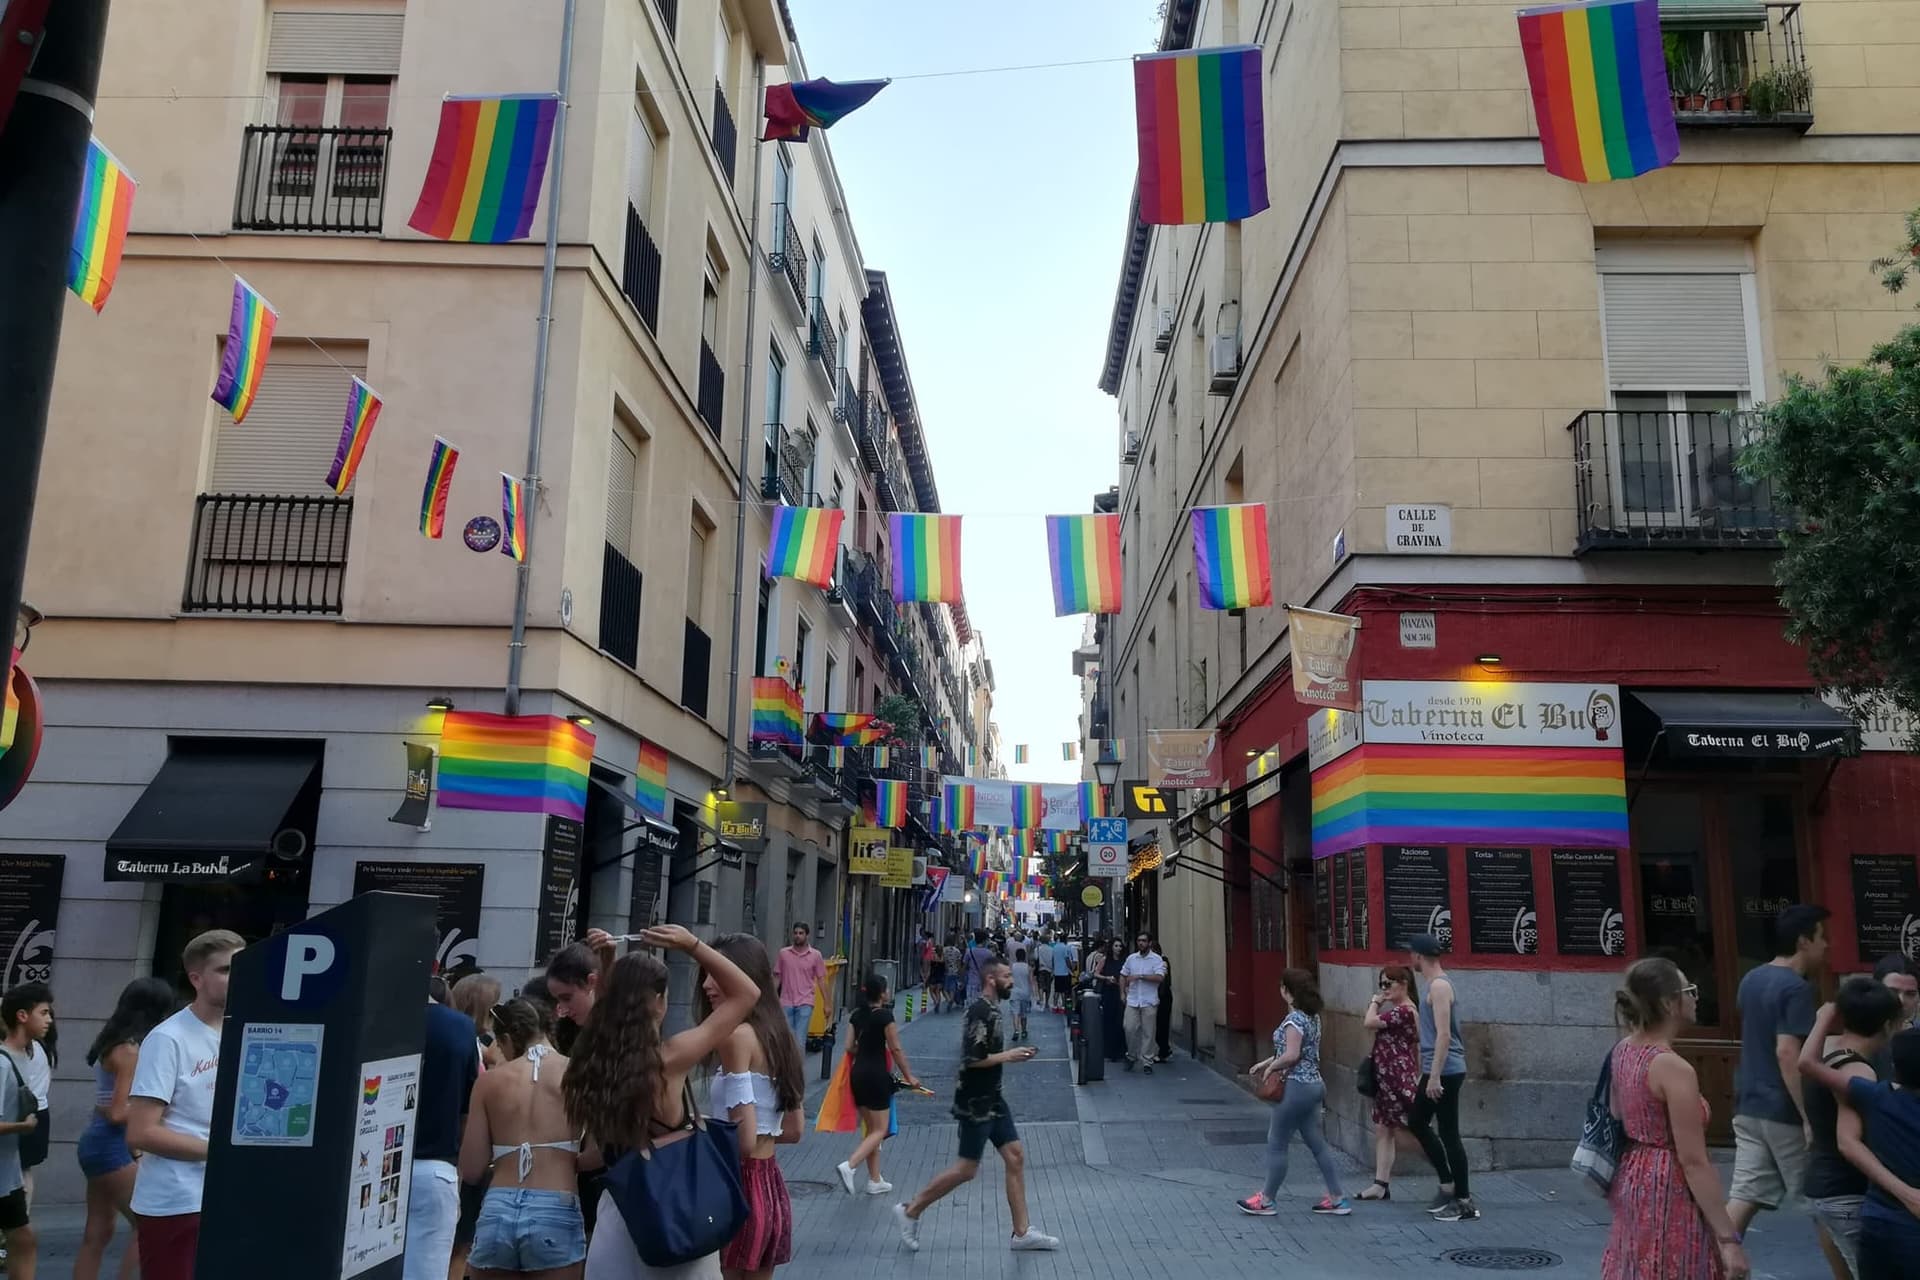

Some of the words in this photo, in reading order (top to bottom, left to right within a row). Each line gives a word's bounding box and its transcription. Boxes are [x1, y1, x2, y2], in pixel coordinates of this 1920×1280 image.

[1399, 509, 1436, 520] CALLE
[1412, 523, 1424, 532] DE
[1428, 696, 1456, 706] desde
[1459, 697, 1482, 706] 1970
[1367, 698, 1484, 728] Taberna
[1491, 702, 1527, 730] El
[1420, 729, 1484, 742] Vinoteca
[1687, 733, 1745, 748] Taberna
[1751, 734, 1769, 748] El
[852, 840, 887, 859] life
[117, 860, 169, 873] Taberna
[172, 862, 190, 875] La
[281, 934, 335, 1000] P
